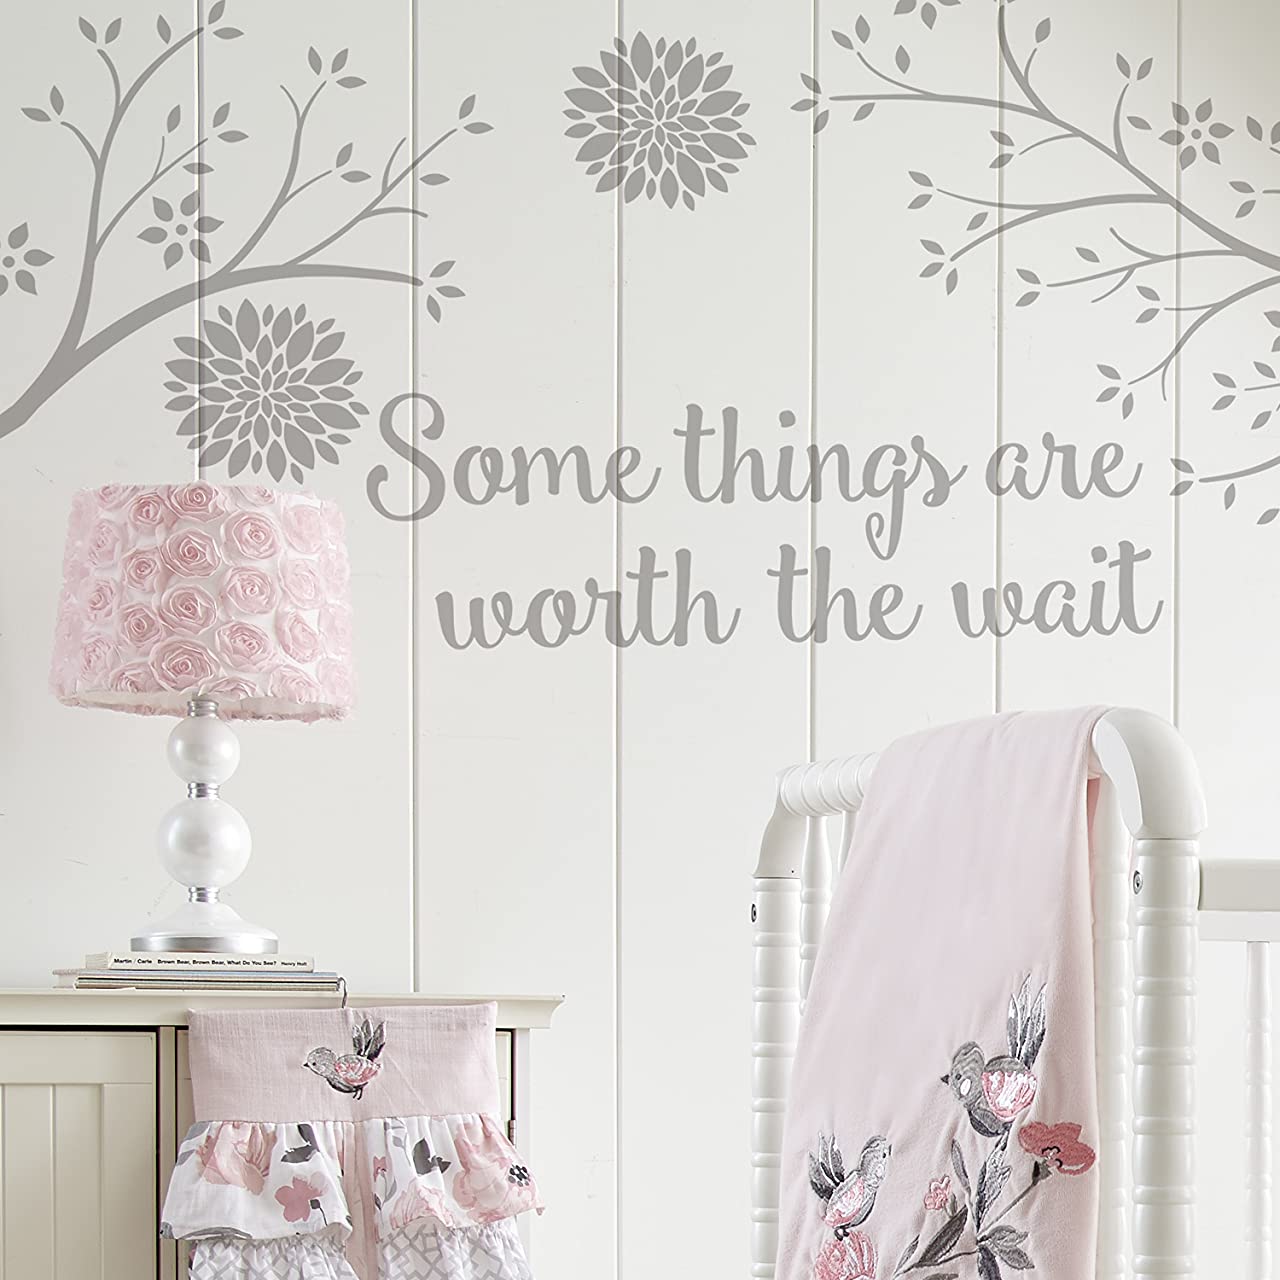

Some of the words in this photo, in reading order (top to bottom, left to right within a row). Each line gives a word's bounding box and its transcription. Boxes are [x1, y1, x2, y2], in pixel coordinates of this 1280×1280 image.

[366, 393, 661, 522] Some
[673, 403, 969, 561] things
[984, 432, 1143, 503] are
[435, 546, 742, 651] worth
[766, 544, 924, 645] the
[951, 540, 1165, 640] wait
